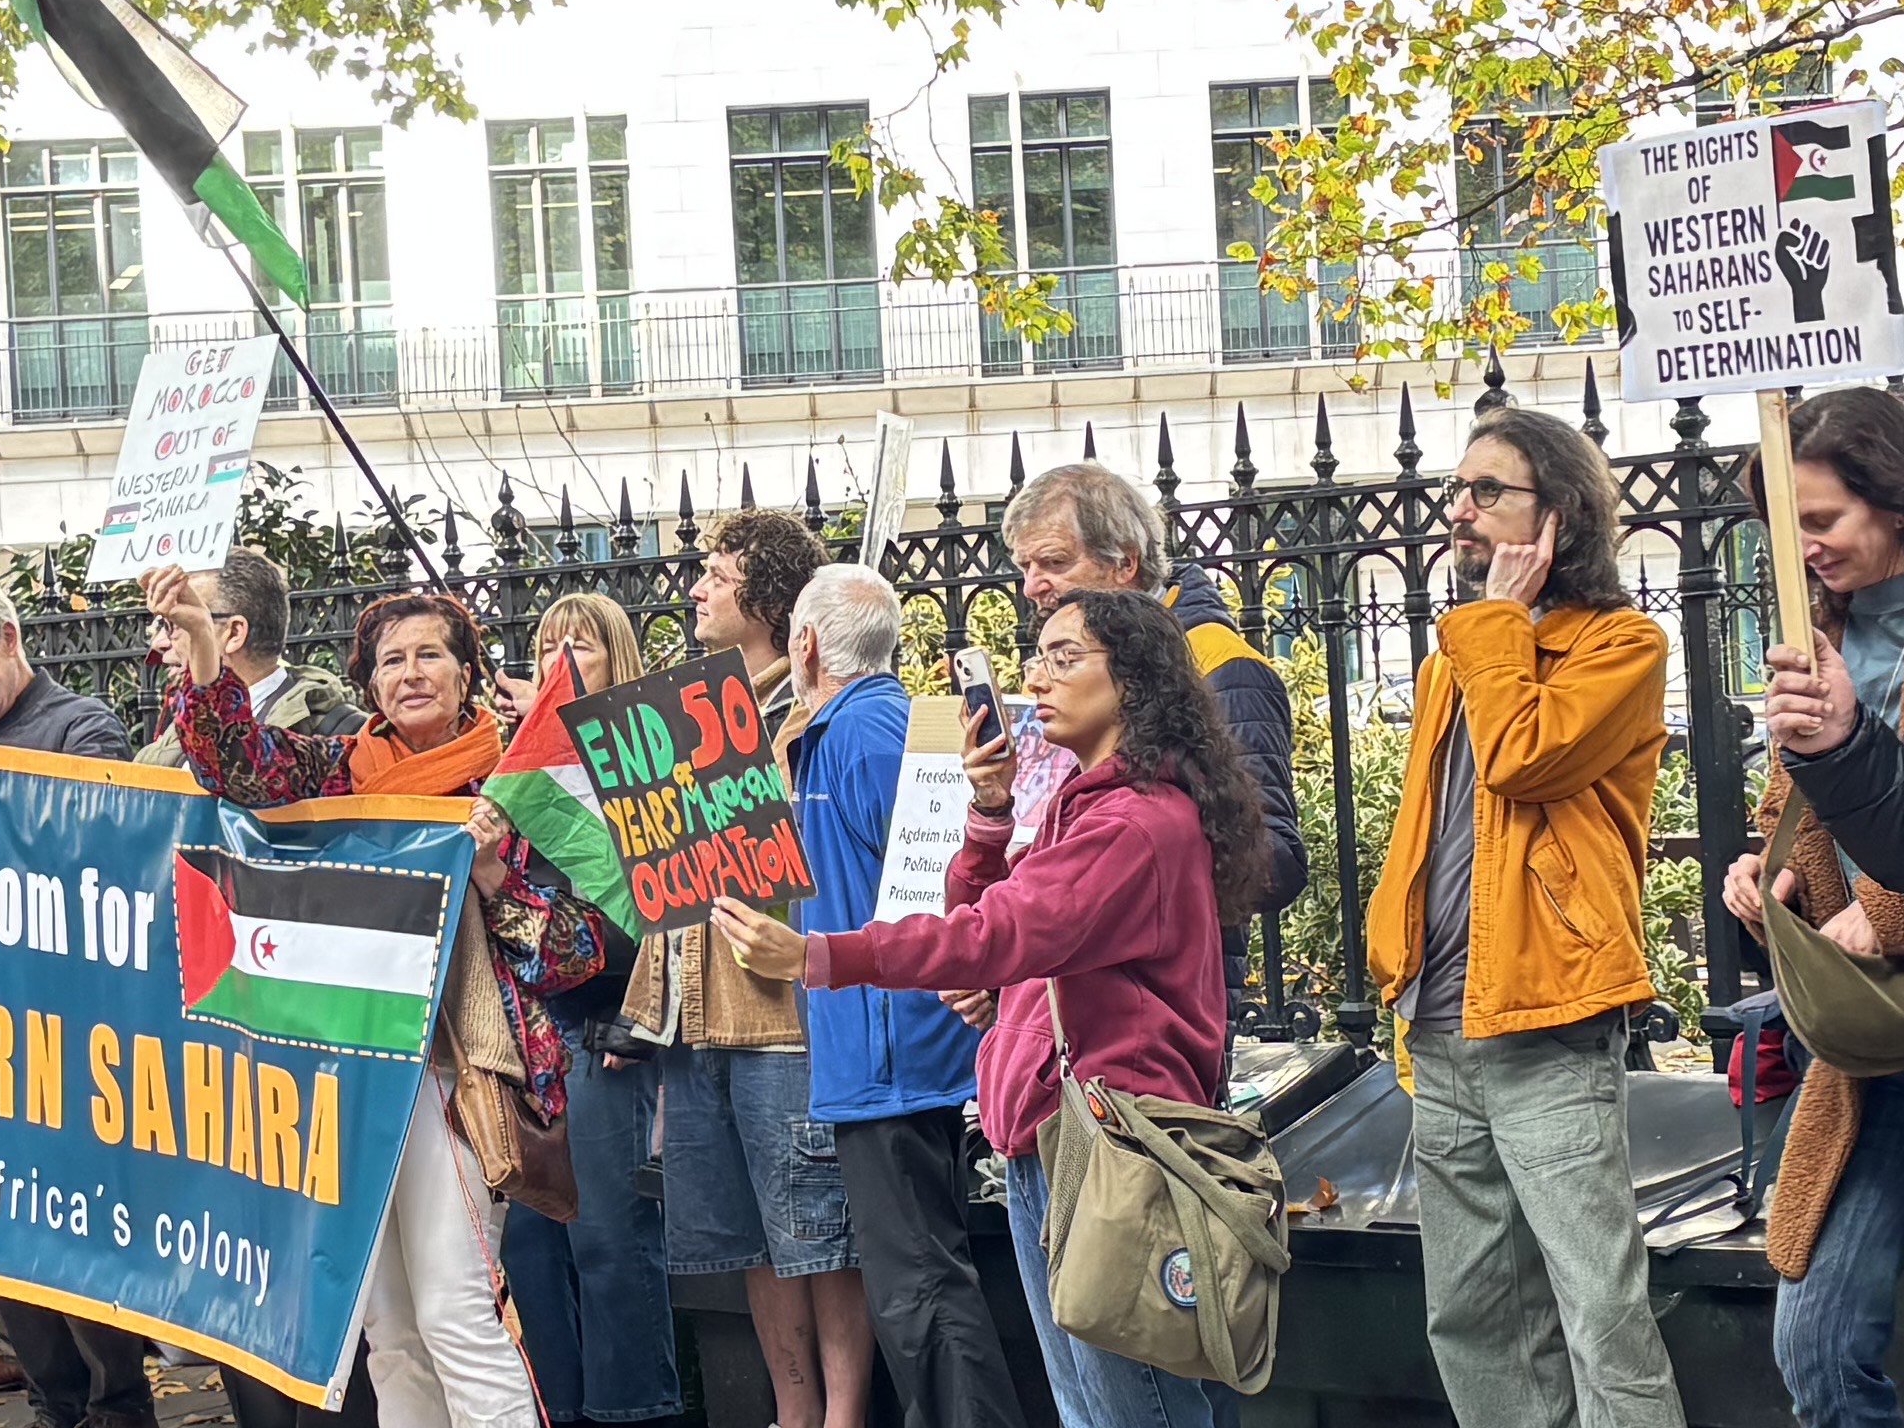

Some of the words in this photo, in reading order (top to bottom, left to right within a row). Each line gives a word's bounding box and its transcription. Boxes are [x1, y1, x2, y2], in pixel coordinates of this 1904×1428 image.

[1641, 143, 1678, 176] THE
[1685, 129, 1759, 169] RIGHTS
[1688, 175, 1712, 204] OF
[1644, 205, 1767, 257] WESTERN
[1648, 250, 1772, 297] SAHARANS
[1673, 309, 1693, 332] TO
[1700, 297, 1762, 334] SELF-
[185, 346, 235, 376] GET
[1657, 326, 1862, 383] DETERMINATION
[147, 376, 255, 421] MOROCCO
[155, 426, 208, 460] OUT
[212, 420, 238, 447] OF
[117, 464, 200, 497] WESTERN
[142, 491, 209, 523] SAHARA
[121, 522, 222, 564] NOW!
[577, 703, 673, 789] END
[679, 675, 759, 770] 50
[915, 768, 964, 785] Freedom
[602, 786, 682, 858] YEARS
[673, 761, 695, 793] OF
[929, 799, 941, 813] to
[899, 826, 940, 845] Agdeim
[631, 818, 812, 923] OCCUPATION
[80, 866, 155, 972] for
[89, 1023, 341, 1206] SAHARA
[156, 1211, 270, 1307] colony
